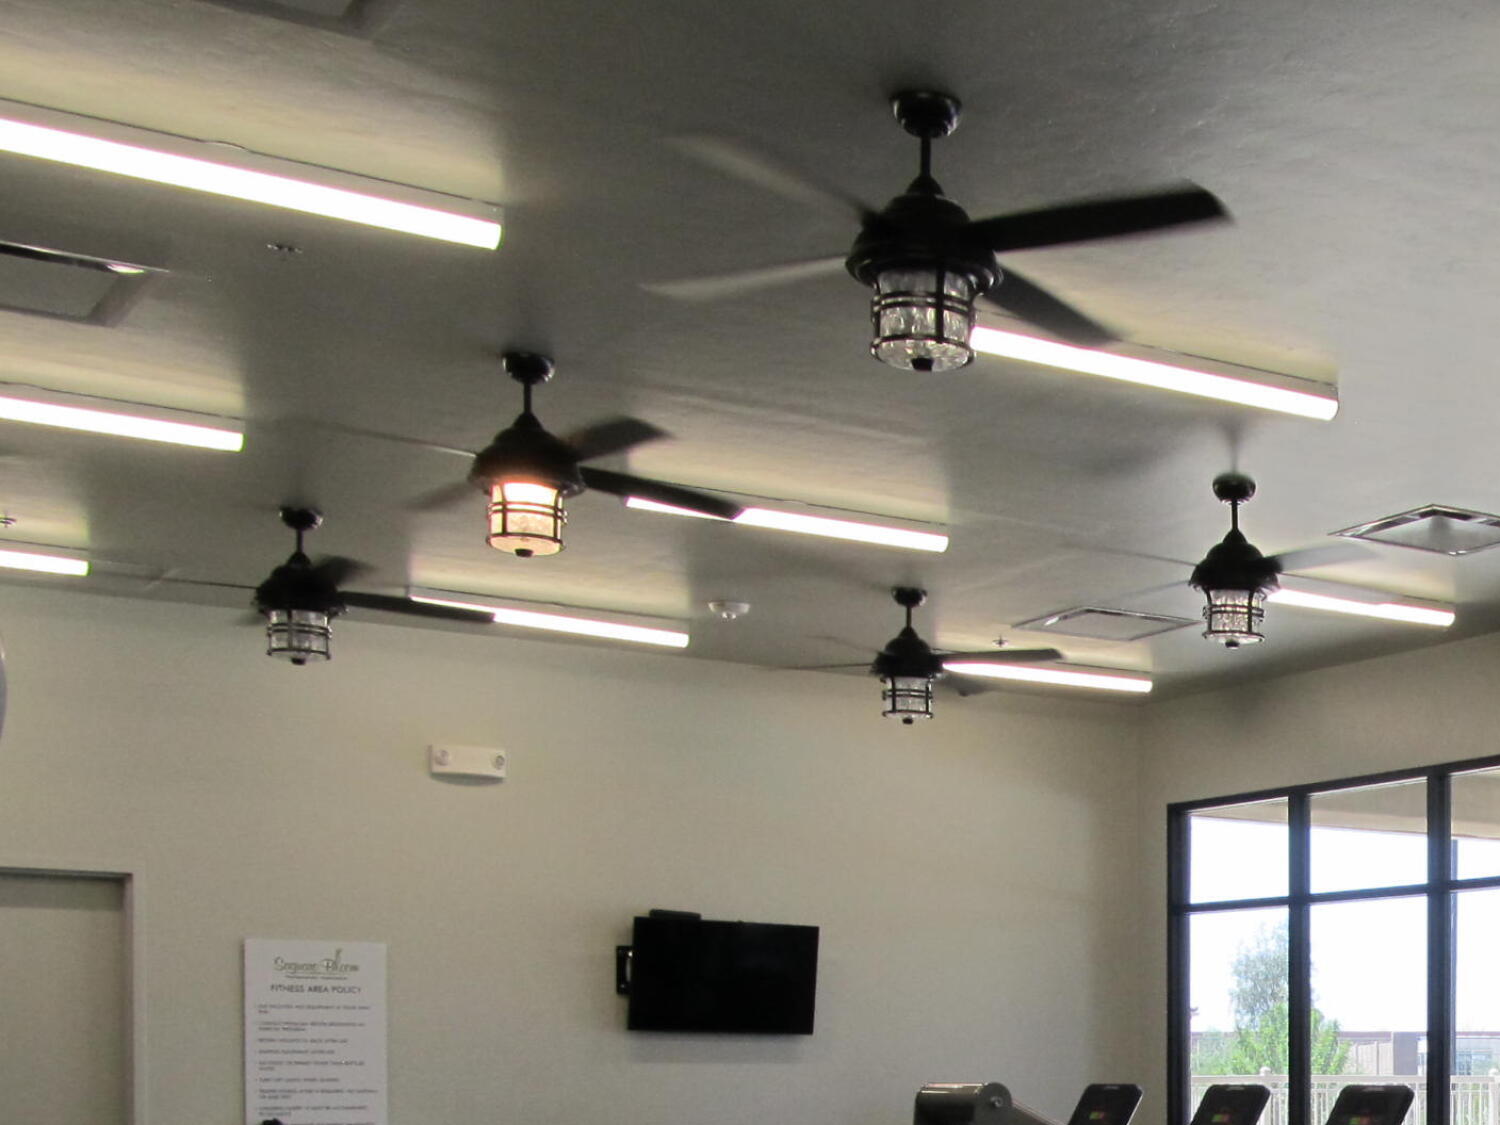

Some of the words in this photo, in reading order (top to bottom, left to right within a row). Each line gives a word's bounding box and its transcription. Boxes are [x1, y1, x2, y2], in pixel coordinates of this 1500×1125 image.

[270, 984, 305, 993] FITNESS
[307, 985, 329, 993] AREA
[332, 986, 362, 994] POLICY
